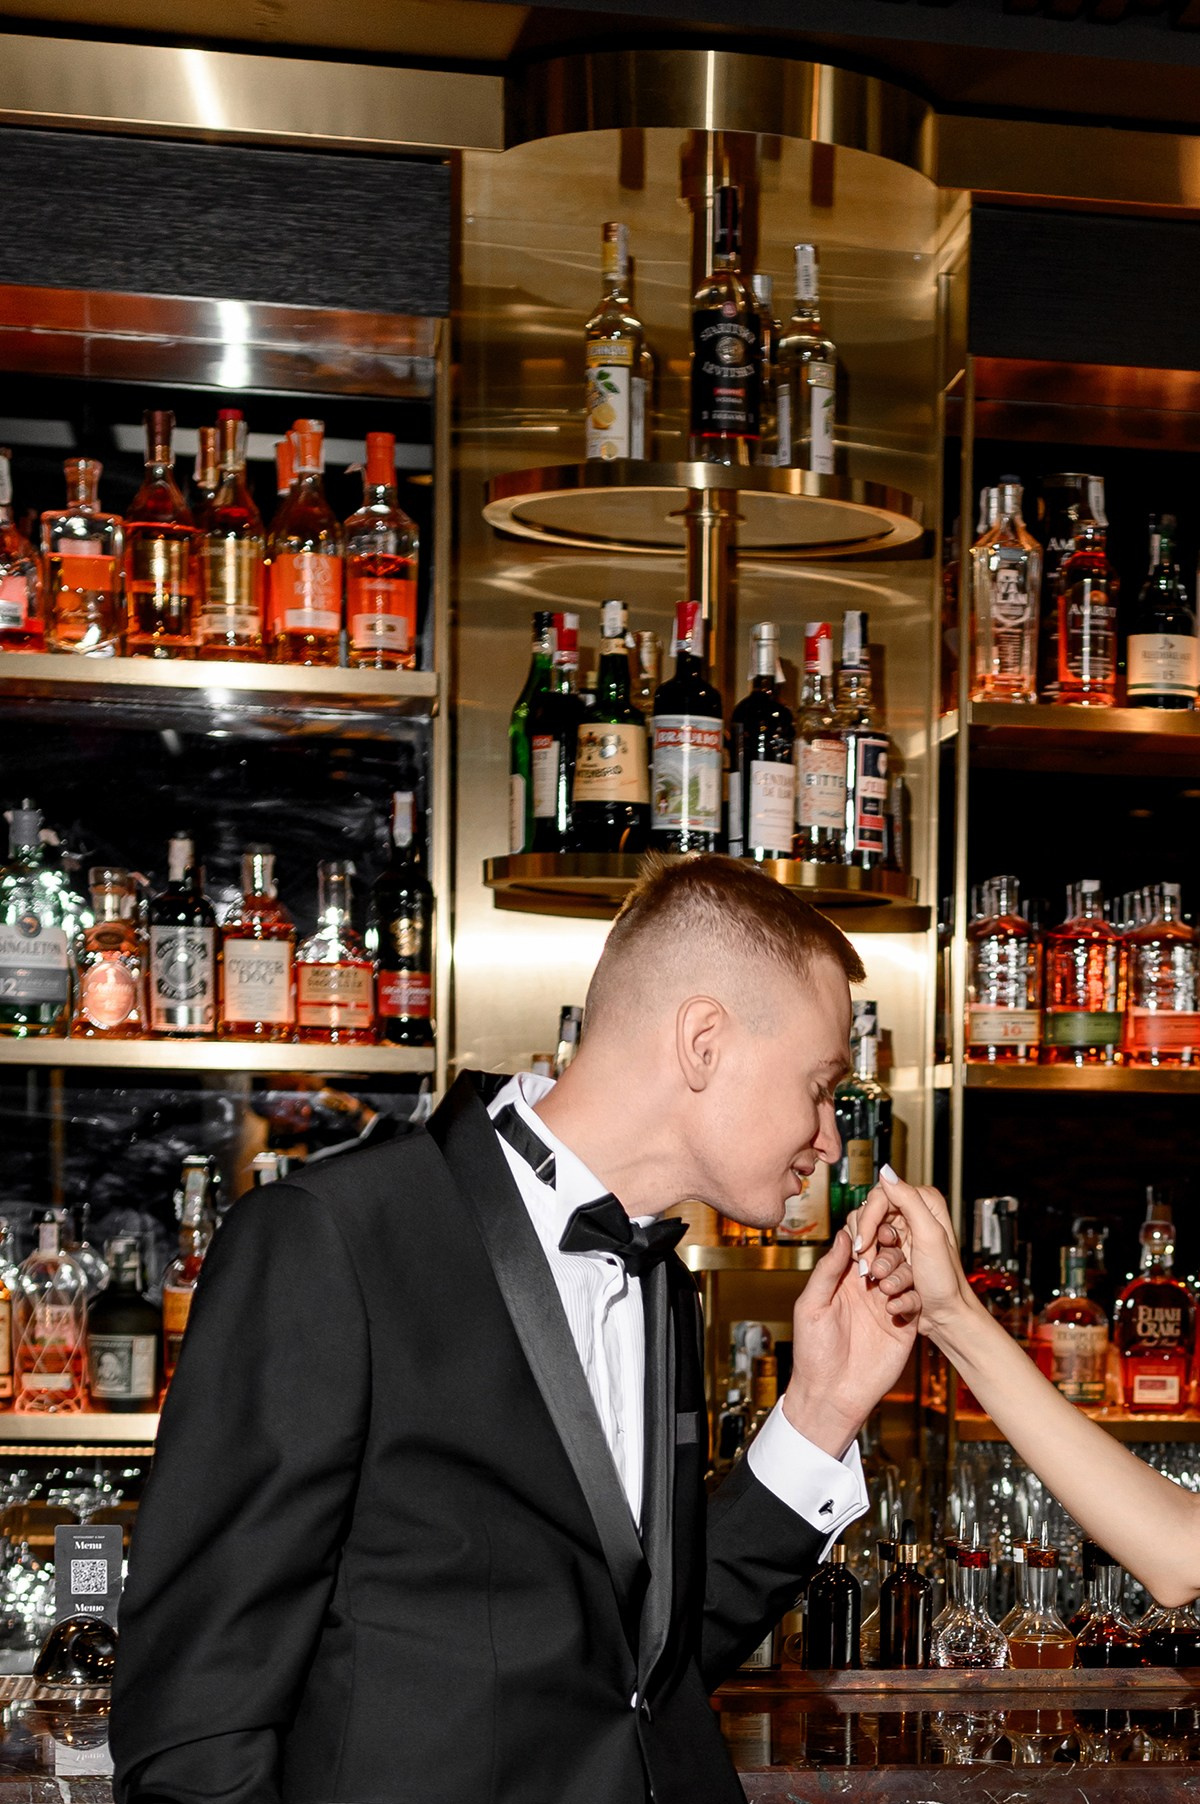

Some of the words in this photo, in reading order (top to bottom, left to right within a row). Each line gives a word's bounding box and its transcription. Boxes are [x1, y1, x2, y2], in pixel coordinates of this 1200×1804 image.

[657, 728, 720, 745] BRAULIO
[1138, 1305, 1182, 1321] ELIJAH
[1136, 1320, 1182, 1338] CRAIG
[75, 1541, 102, 1550] Menu
[75, 1603, 105, 1612] Memo
